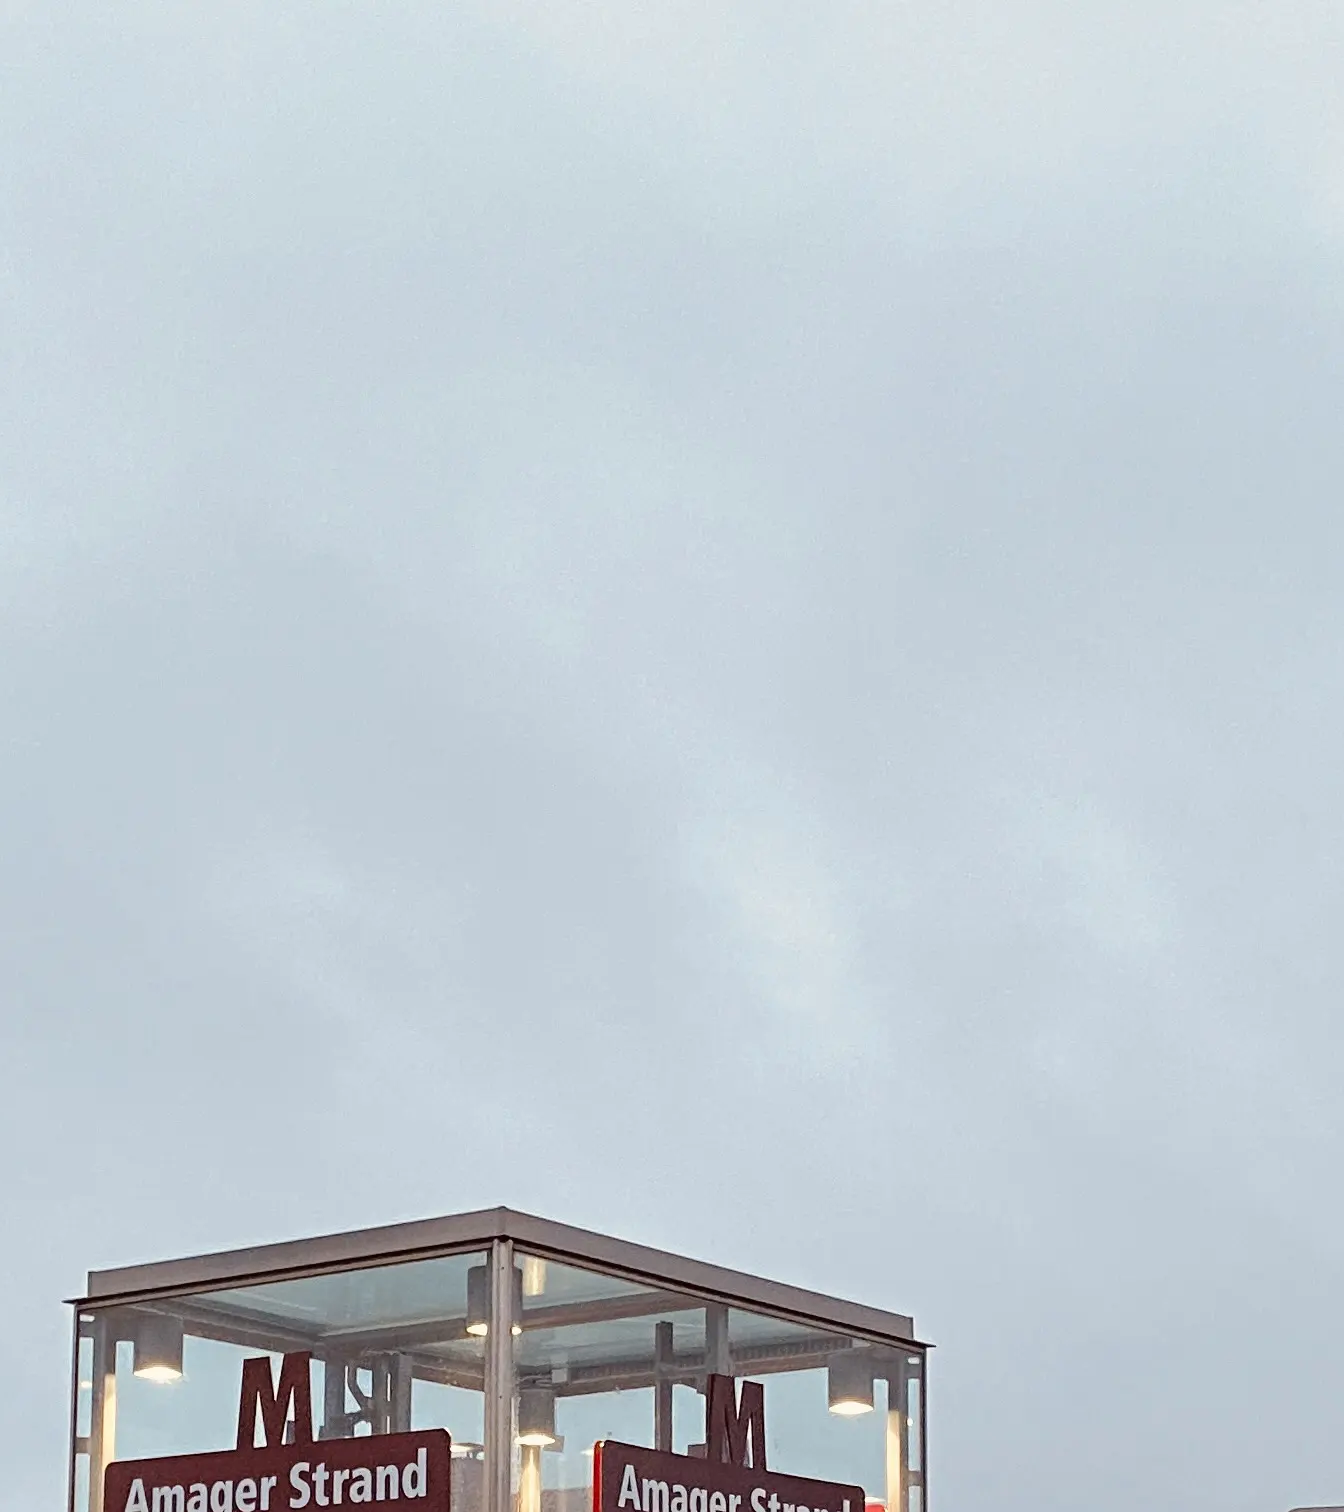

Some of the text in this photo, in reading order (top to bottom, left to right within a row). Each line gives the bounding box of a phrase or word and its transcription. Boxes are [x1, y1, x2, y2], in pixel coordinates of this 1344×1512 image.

[236, 1351, 315, 1450] M
[706, 1373, 768, 1472] M
[288, 1447, 428, 1510] Strand
